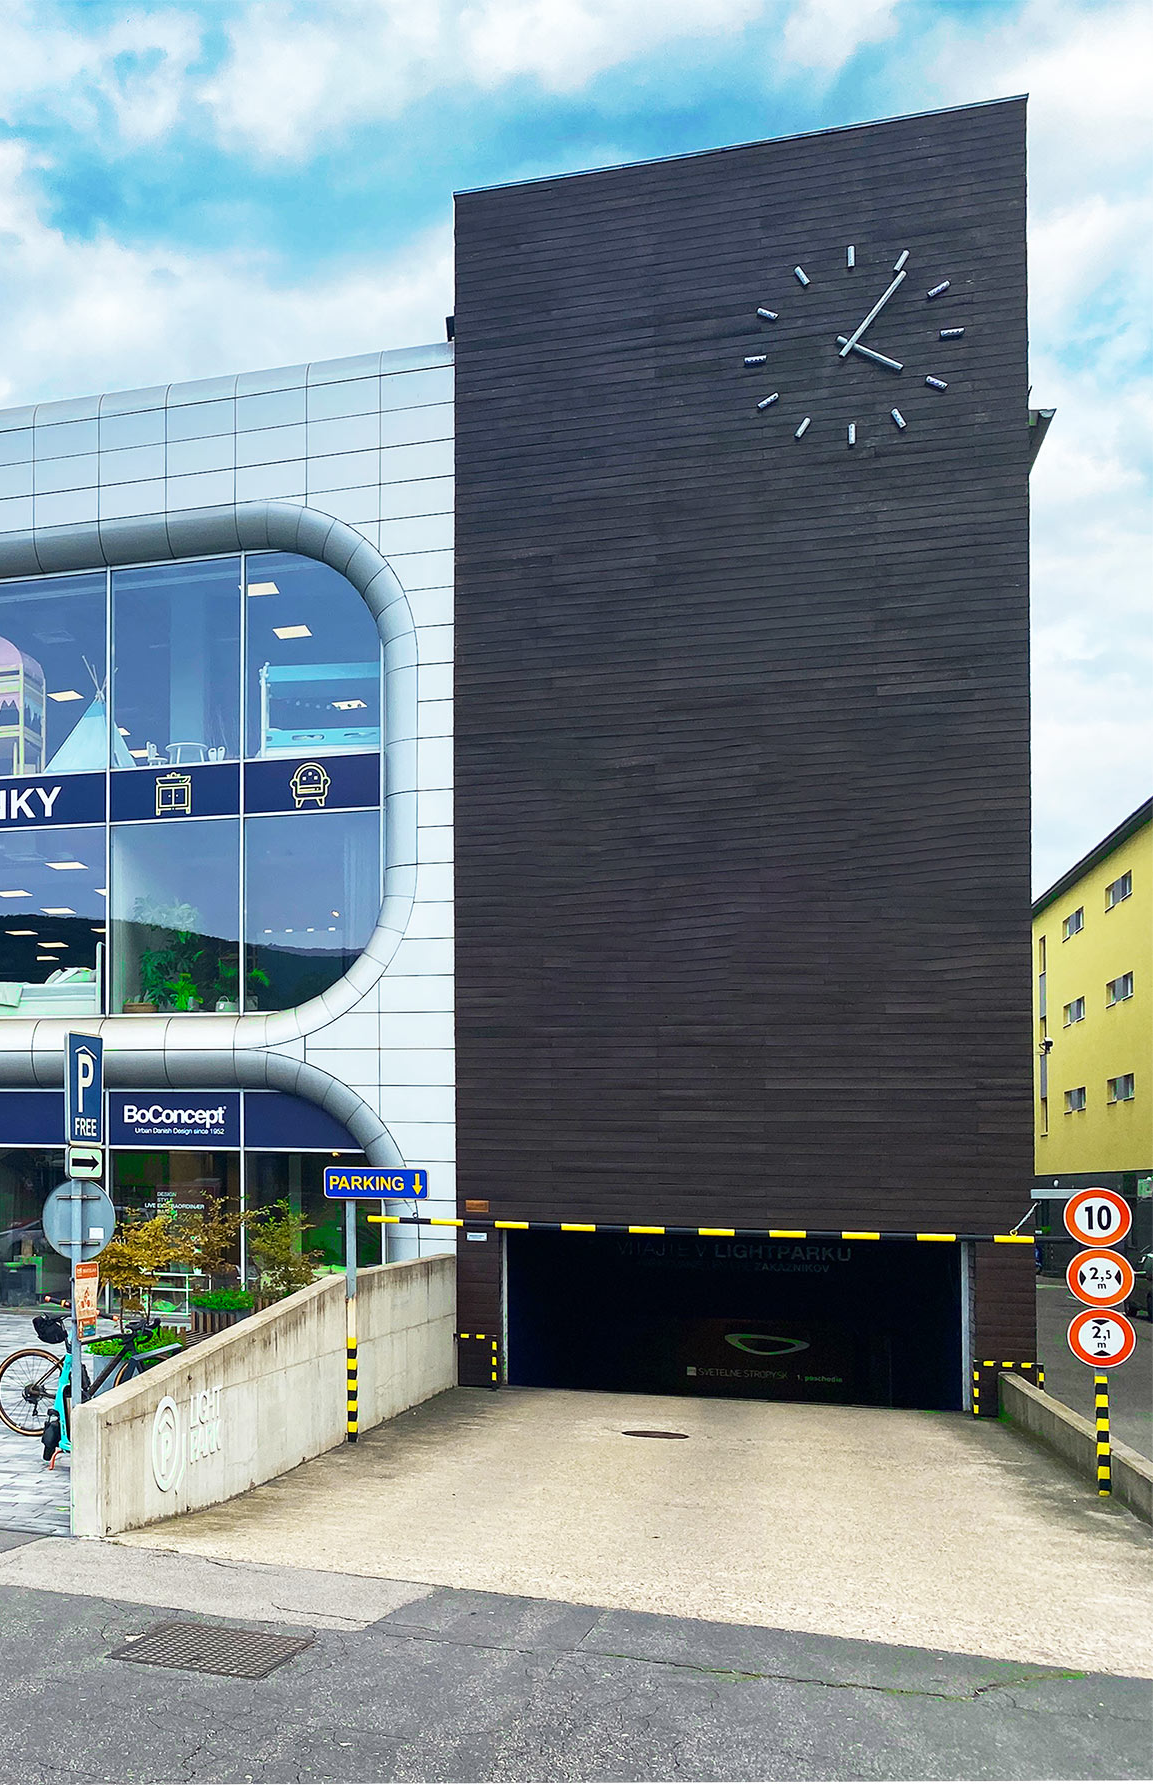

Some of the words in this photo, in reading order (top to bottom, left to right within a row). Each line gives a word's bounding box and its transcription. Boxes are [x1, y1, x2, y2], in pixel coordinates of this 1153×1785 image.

[77, 1053, 94, 1113] P
[123, 1104, 225, 1129] BoConcept
[74, 1117, 97, 1137] FREE
[173, 1127, 193, 1136] Design
[329, 1175, 405, 1191] PARKING
[1085, 1205, 1112, 1231] 10
[1089, 1266, 1112, 1282] 2,5
[1097, 1281, 1107, 1290] m
[1091, 1326, 1111, 1340] 2,1
[1097, 1341, 1107, 1349] m
